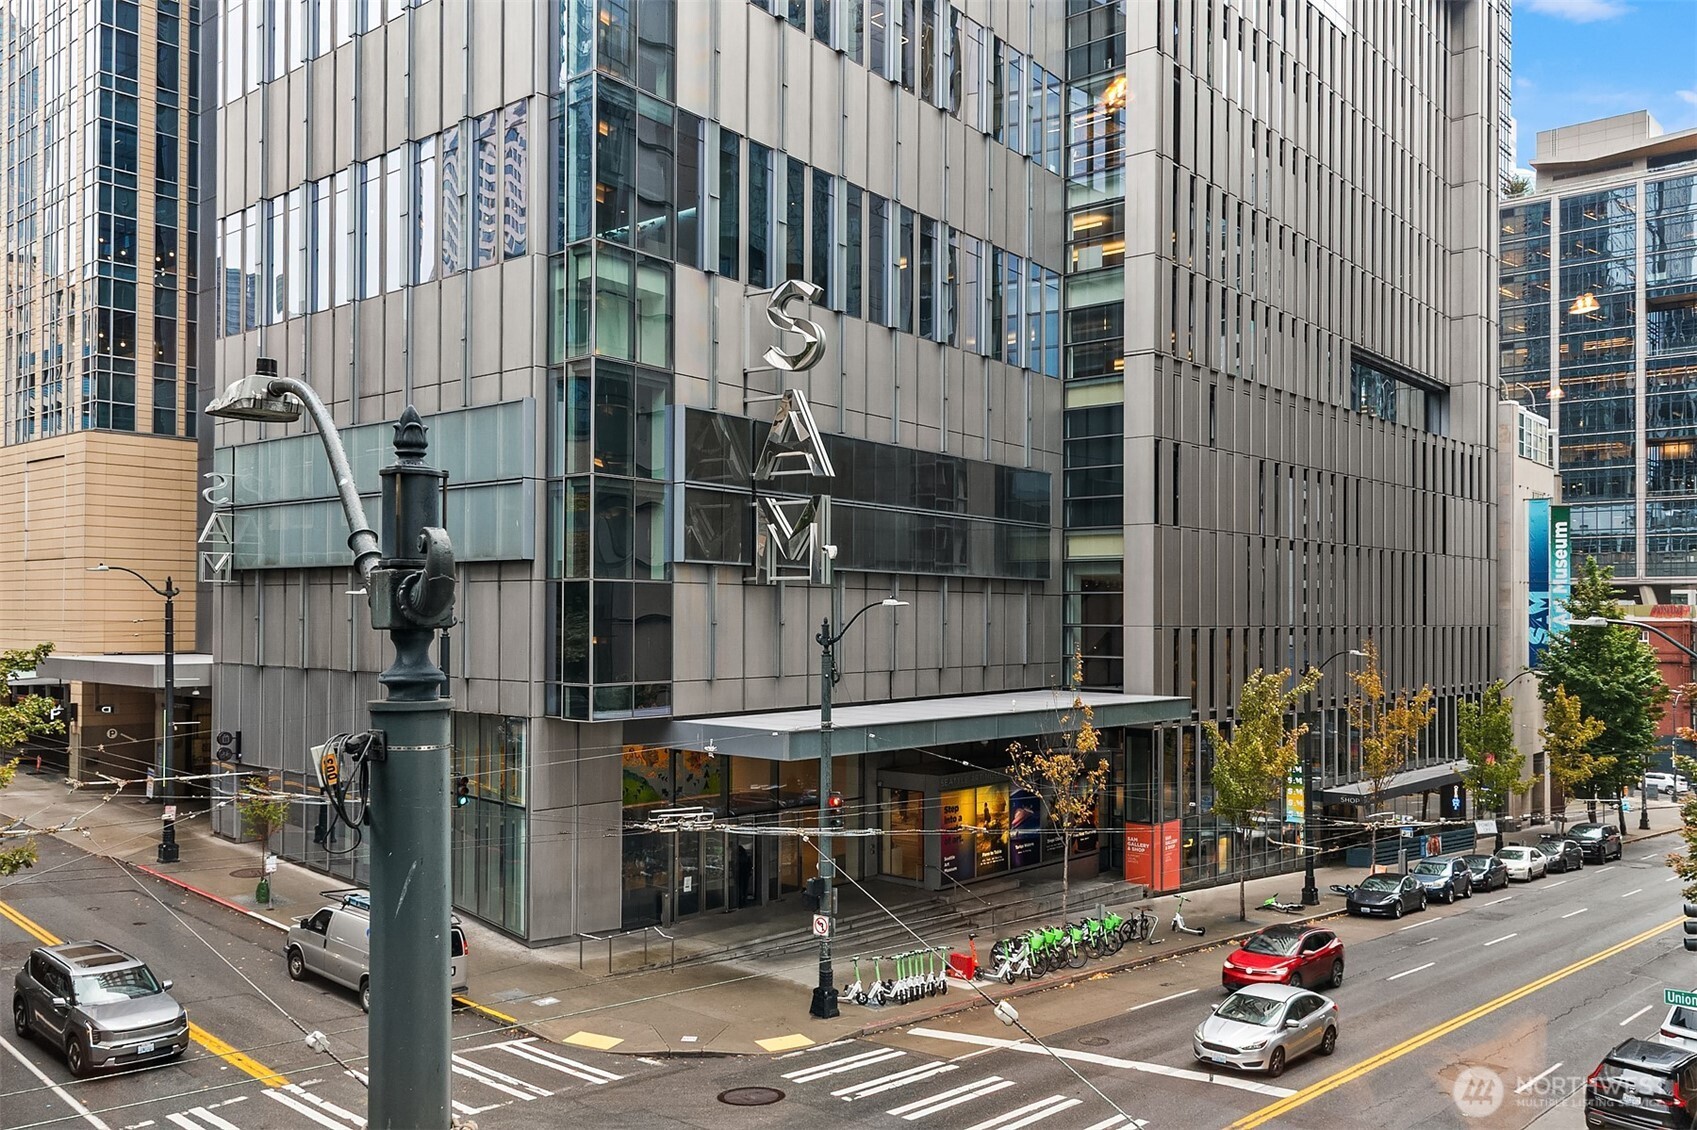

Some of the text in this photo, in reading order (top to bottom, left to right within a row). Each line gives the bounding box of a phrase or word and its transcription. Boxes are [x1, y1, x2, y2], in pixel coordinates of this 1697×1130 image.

[755, 279, 836, 586] SAM
[1553, 521, 1568, 594] Museum
[1529, 592, 1549, 645] SAM
[1340, 796, 1361, 804] SHOP
[944, 805, 959, 814] Step
[944, 816, 957, 824] into
[1667, 991, 1697, 1006] Union
